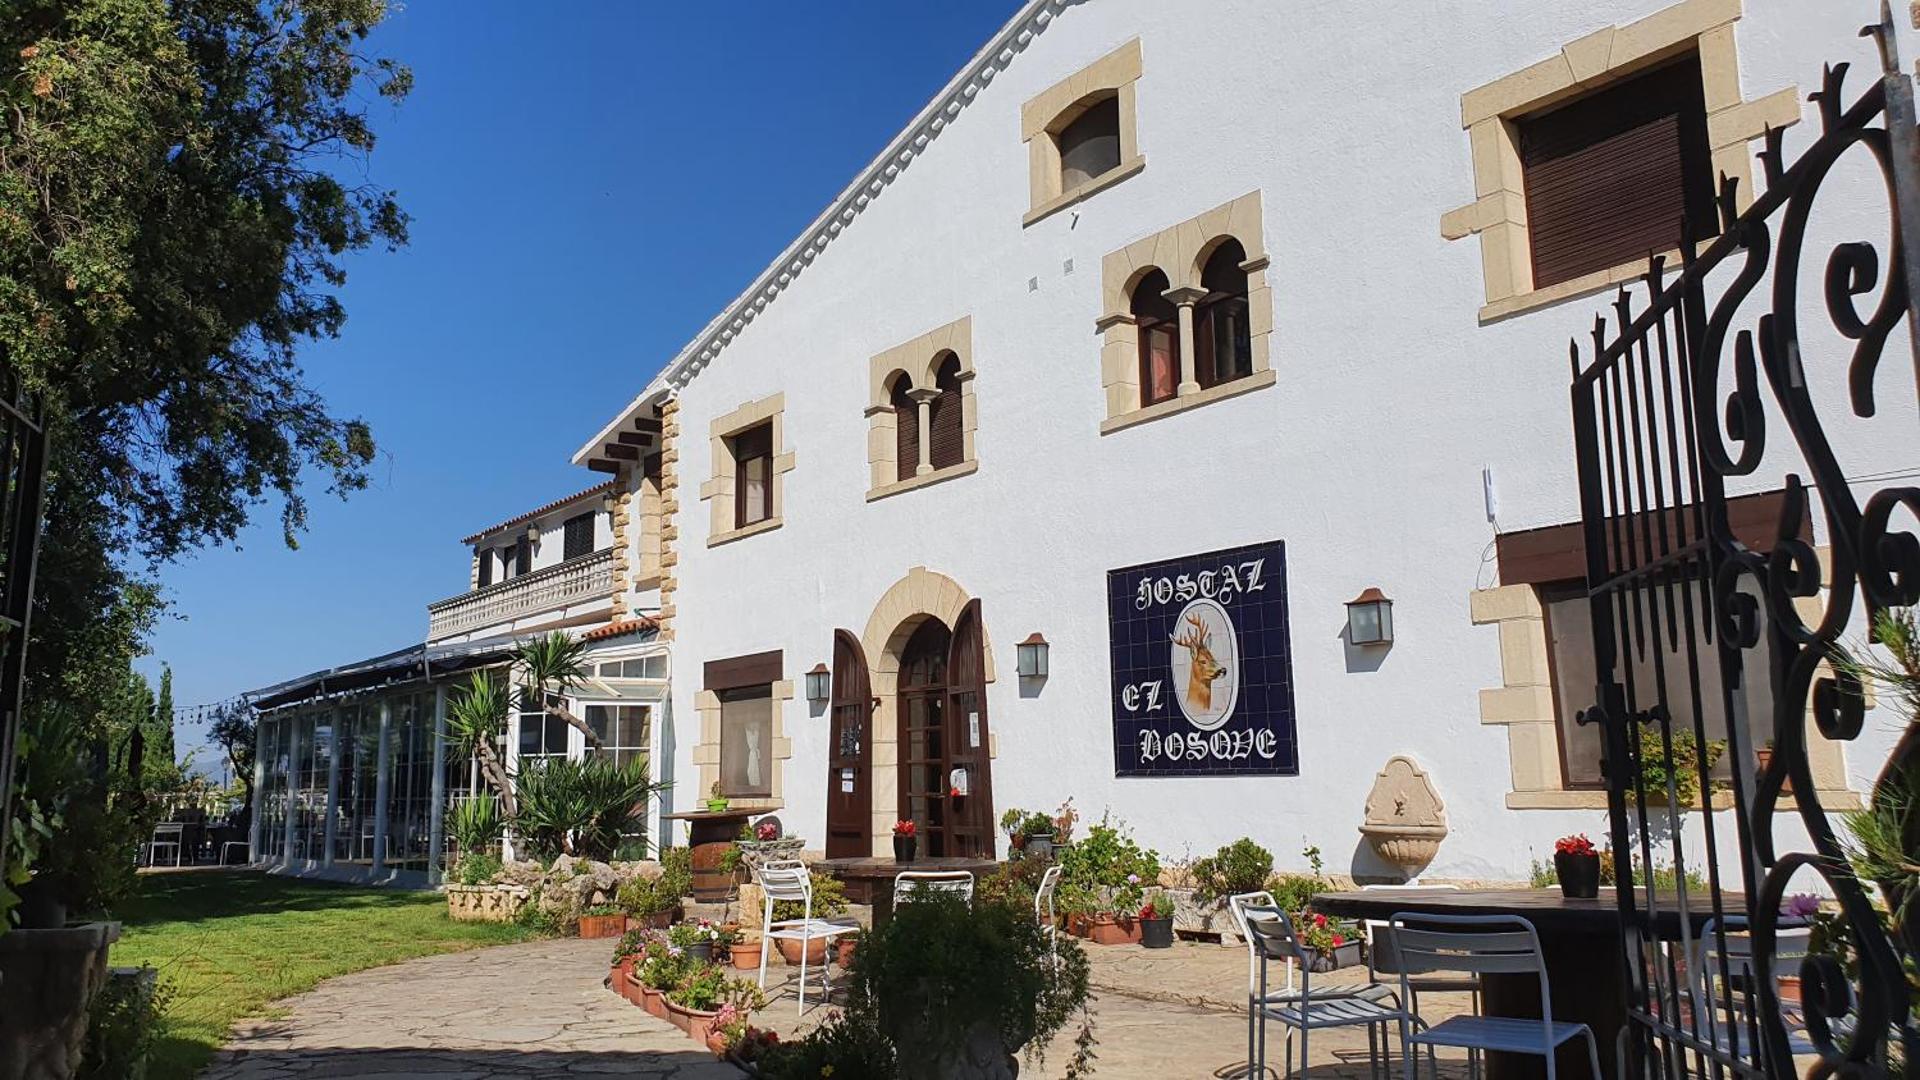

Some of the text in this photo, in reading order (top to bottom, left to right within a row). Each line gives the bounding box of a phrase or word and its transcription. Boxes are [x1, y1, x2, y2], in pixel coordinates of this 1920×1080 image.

[1135, 558, 1266, 610] HOSTAL
[1122, 680, 1164, 712] EL
[1139, 728, 1277, 764] BOSQUE
